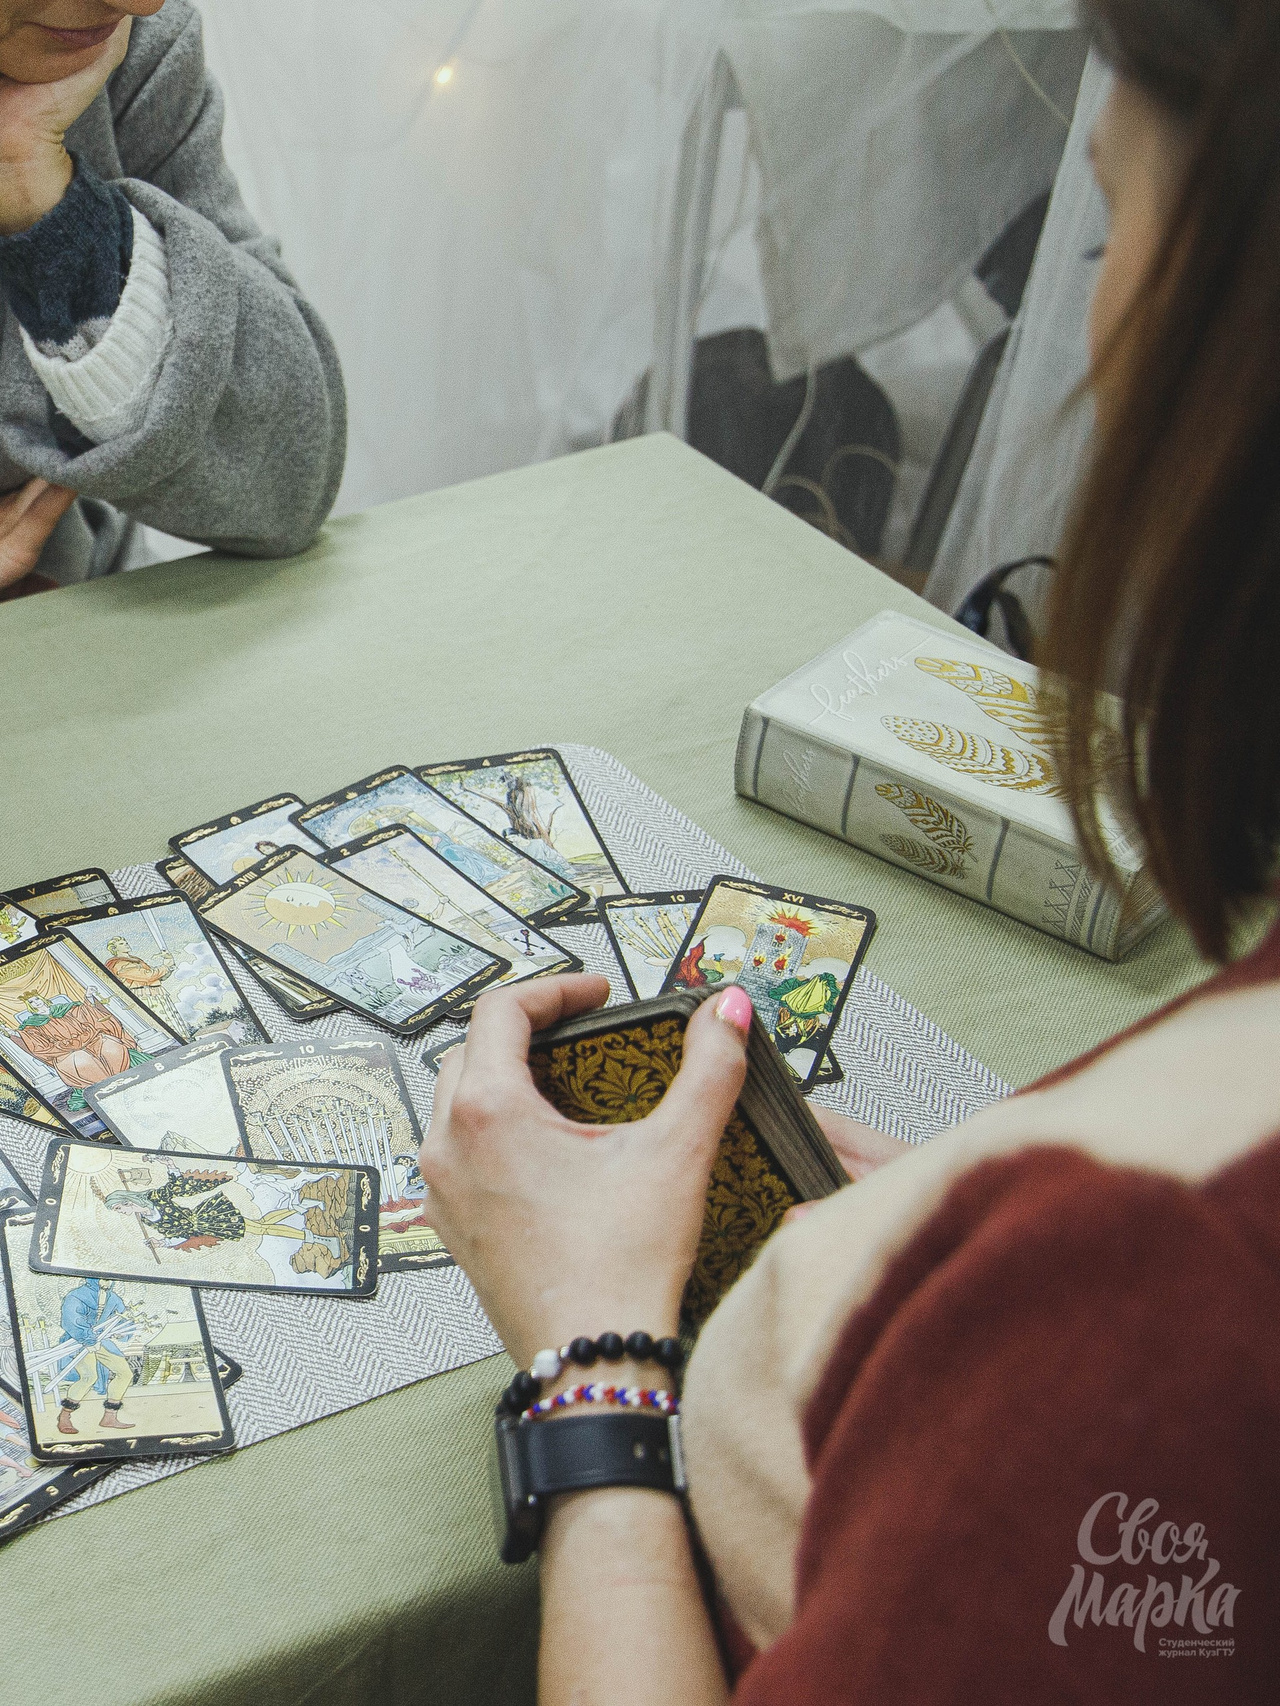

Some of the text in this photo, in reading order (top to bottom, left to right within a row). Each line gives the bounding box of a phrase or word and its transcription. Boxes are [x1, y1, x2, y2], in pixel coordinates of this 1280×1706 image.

[340, 848, 350, 856] 2
[234, 871, 258, 887] XVIII
[670, 894, 685, 903] 10
[782, 892, 804, 904] XVI
[442, 987, 467, 1003] XVIII
[299, 1045, 315, 1055] 10
[154, 1062, 165, 1071] 8
[125, 1439, 137, 1449] 7
[45, 1485, 59, 1496] 3
